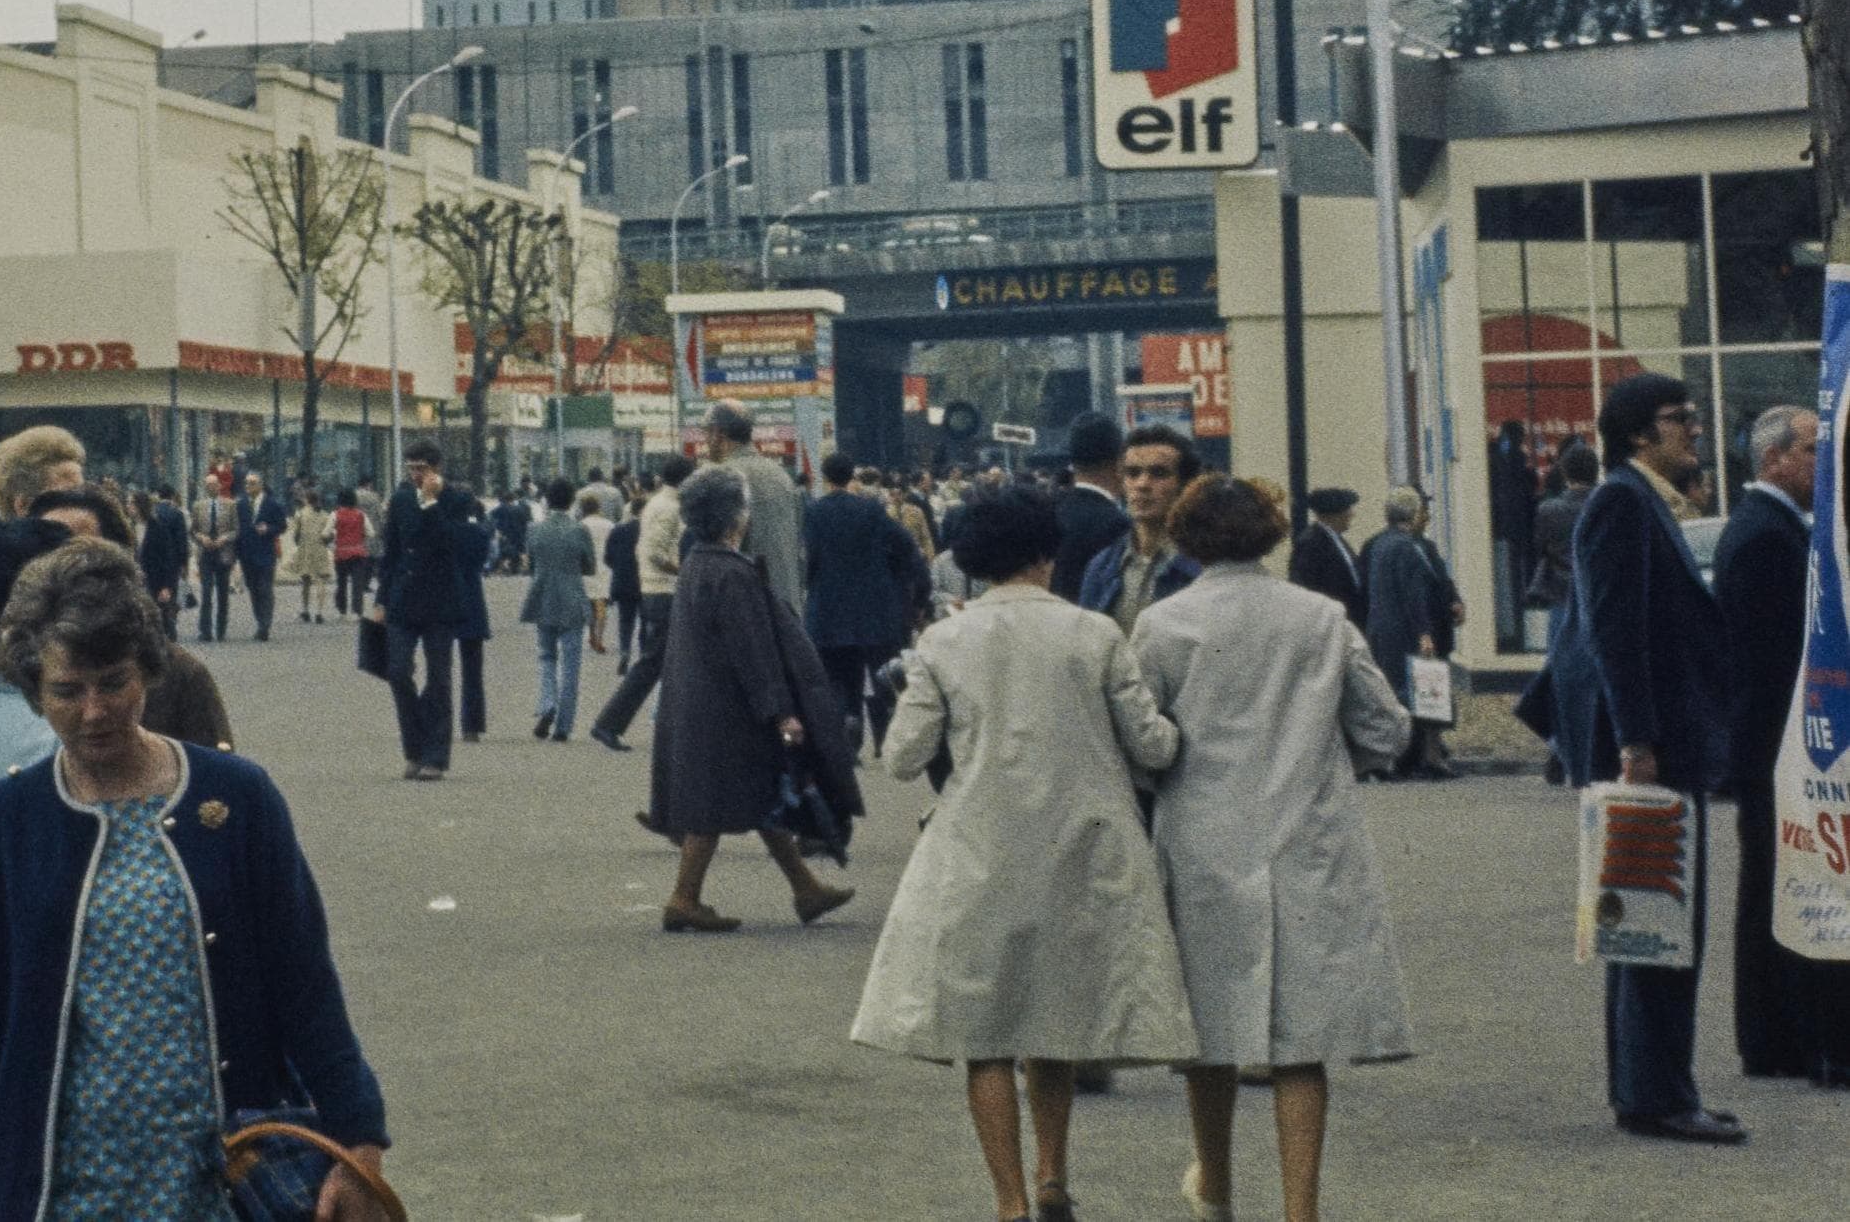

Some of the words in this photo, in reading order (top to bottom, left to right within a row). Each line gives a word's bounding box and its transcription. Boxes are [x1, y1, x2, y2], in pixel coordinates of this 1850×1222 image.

[1116, 96, 1234, 155] elf
[953, 266, 1178, 305] CHAUFFAGE
[16, 342, 138, 375] DDR
